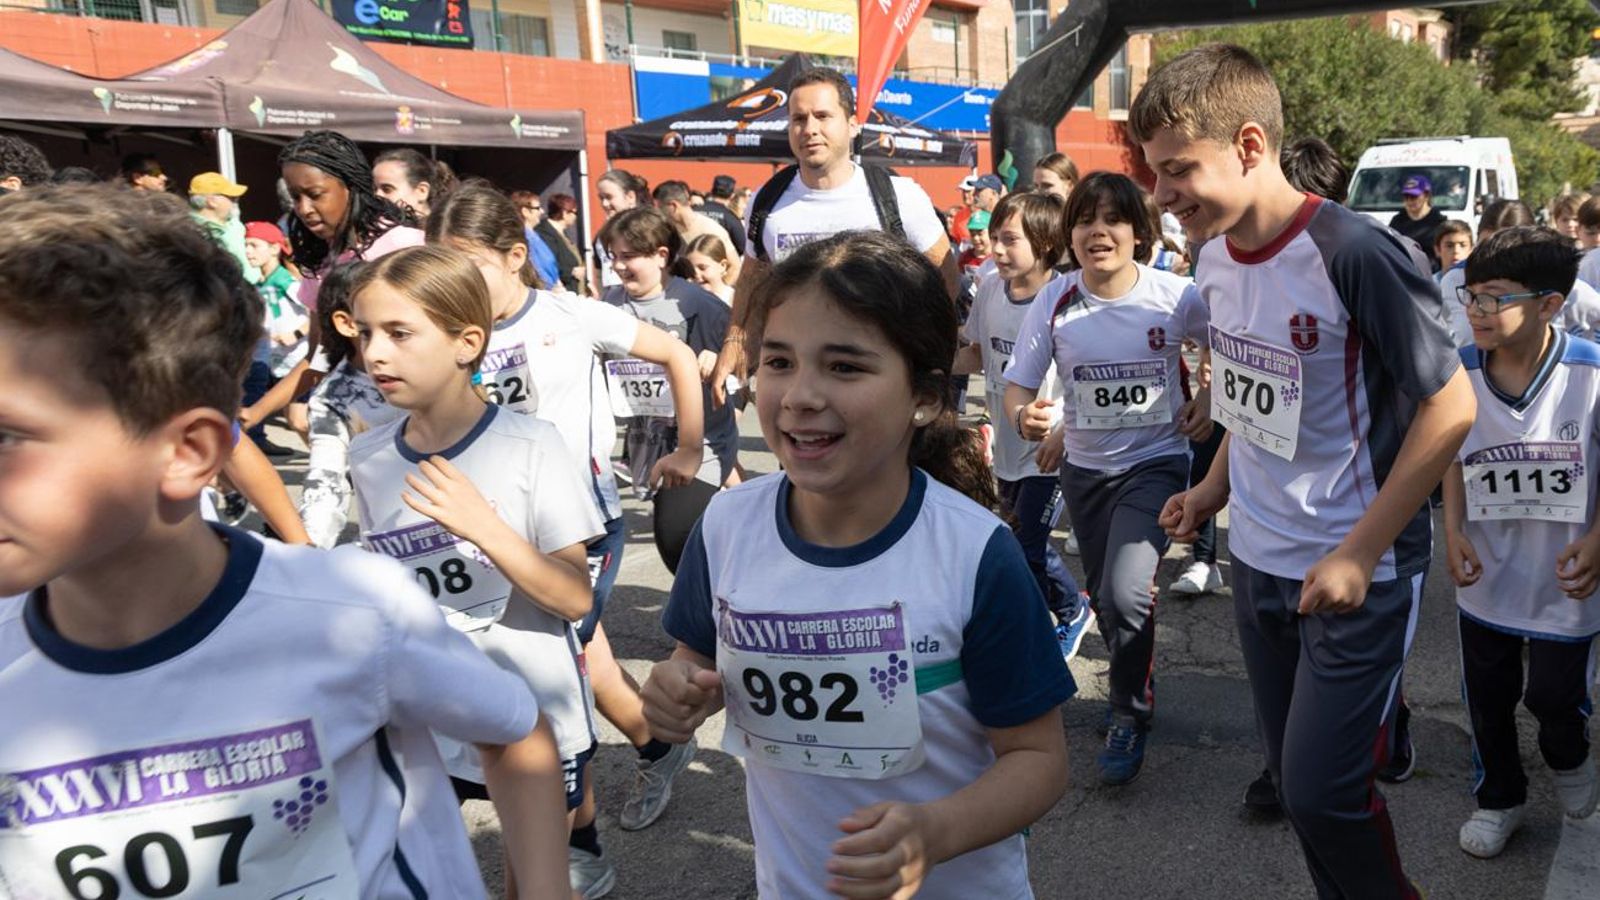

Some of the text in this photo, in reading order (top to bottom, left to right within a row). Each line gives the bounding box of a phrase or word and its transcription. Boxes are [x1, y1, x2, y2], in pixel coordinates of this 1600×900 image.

[767, 3, 854, 36] masymas
[621, 380, 665, 398] 1337
[1094, 385, 1147, 407] 840
[1224, 368, 1275, 416] 870
[1481, 469, 1572, 494] 1113
[787, 620, 839, 635] CARRERA
[841, 614, 896, 633] ESCOLAR
[799, 630, 881, 650] LA GLORIA
[742, 667, 864, 722] 982
[139, 744, 223, 778] CARRERA
[225, 730, 306, 764] ESCOLAR
[158, 753, 288, 798] LA GLORIA
[54, 813, 256, 900] 607
